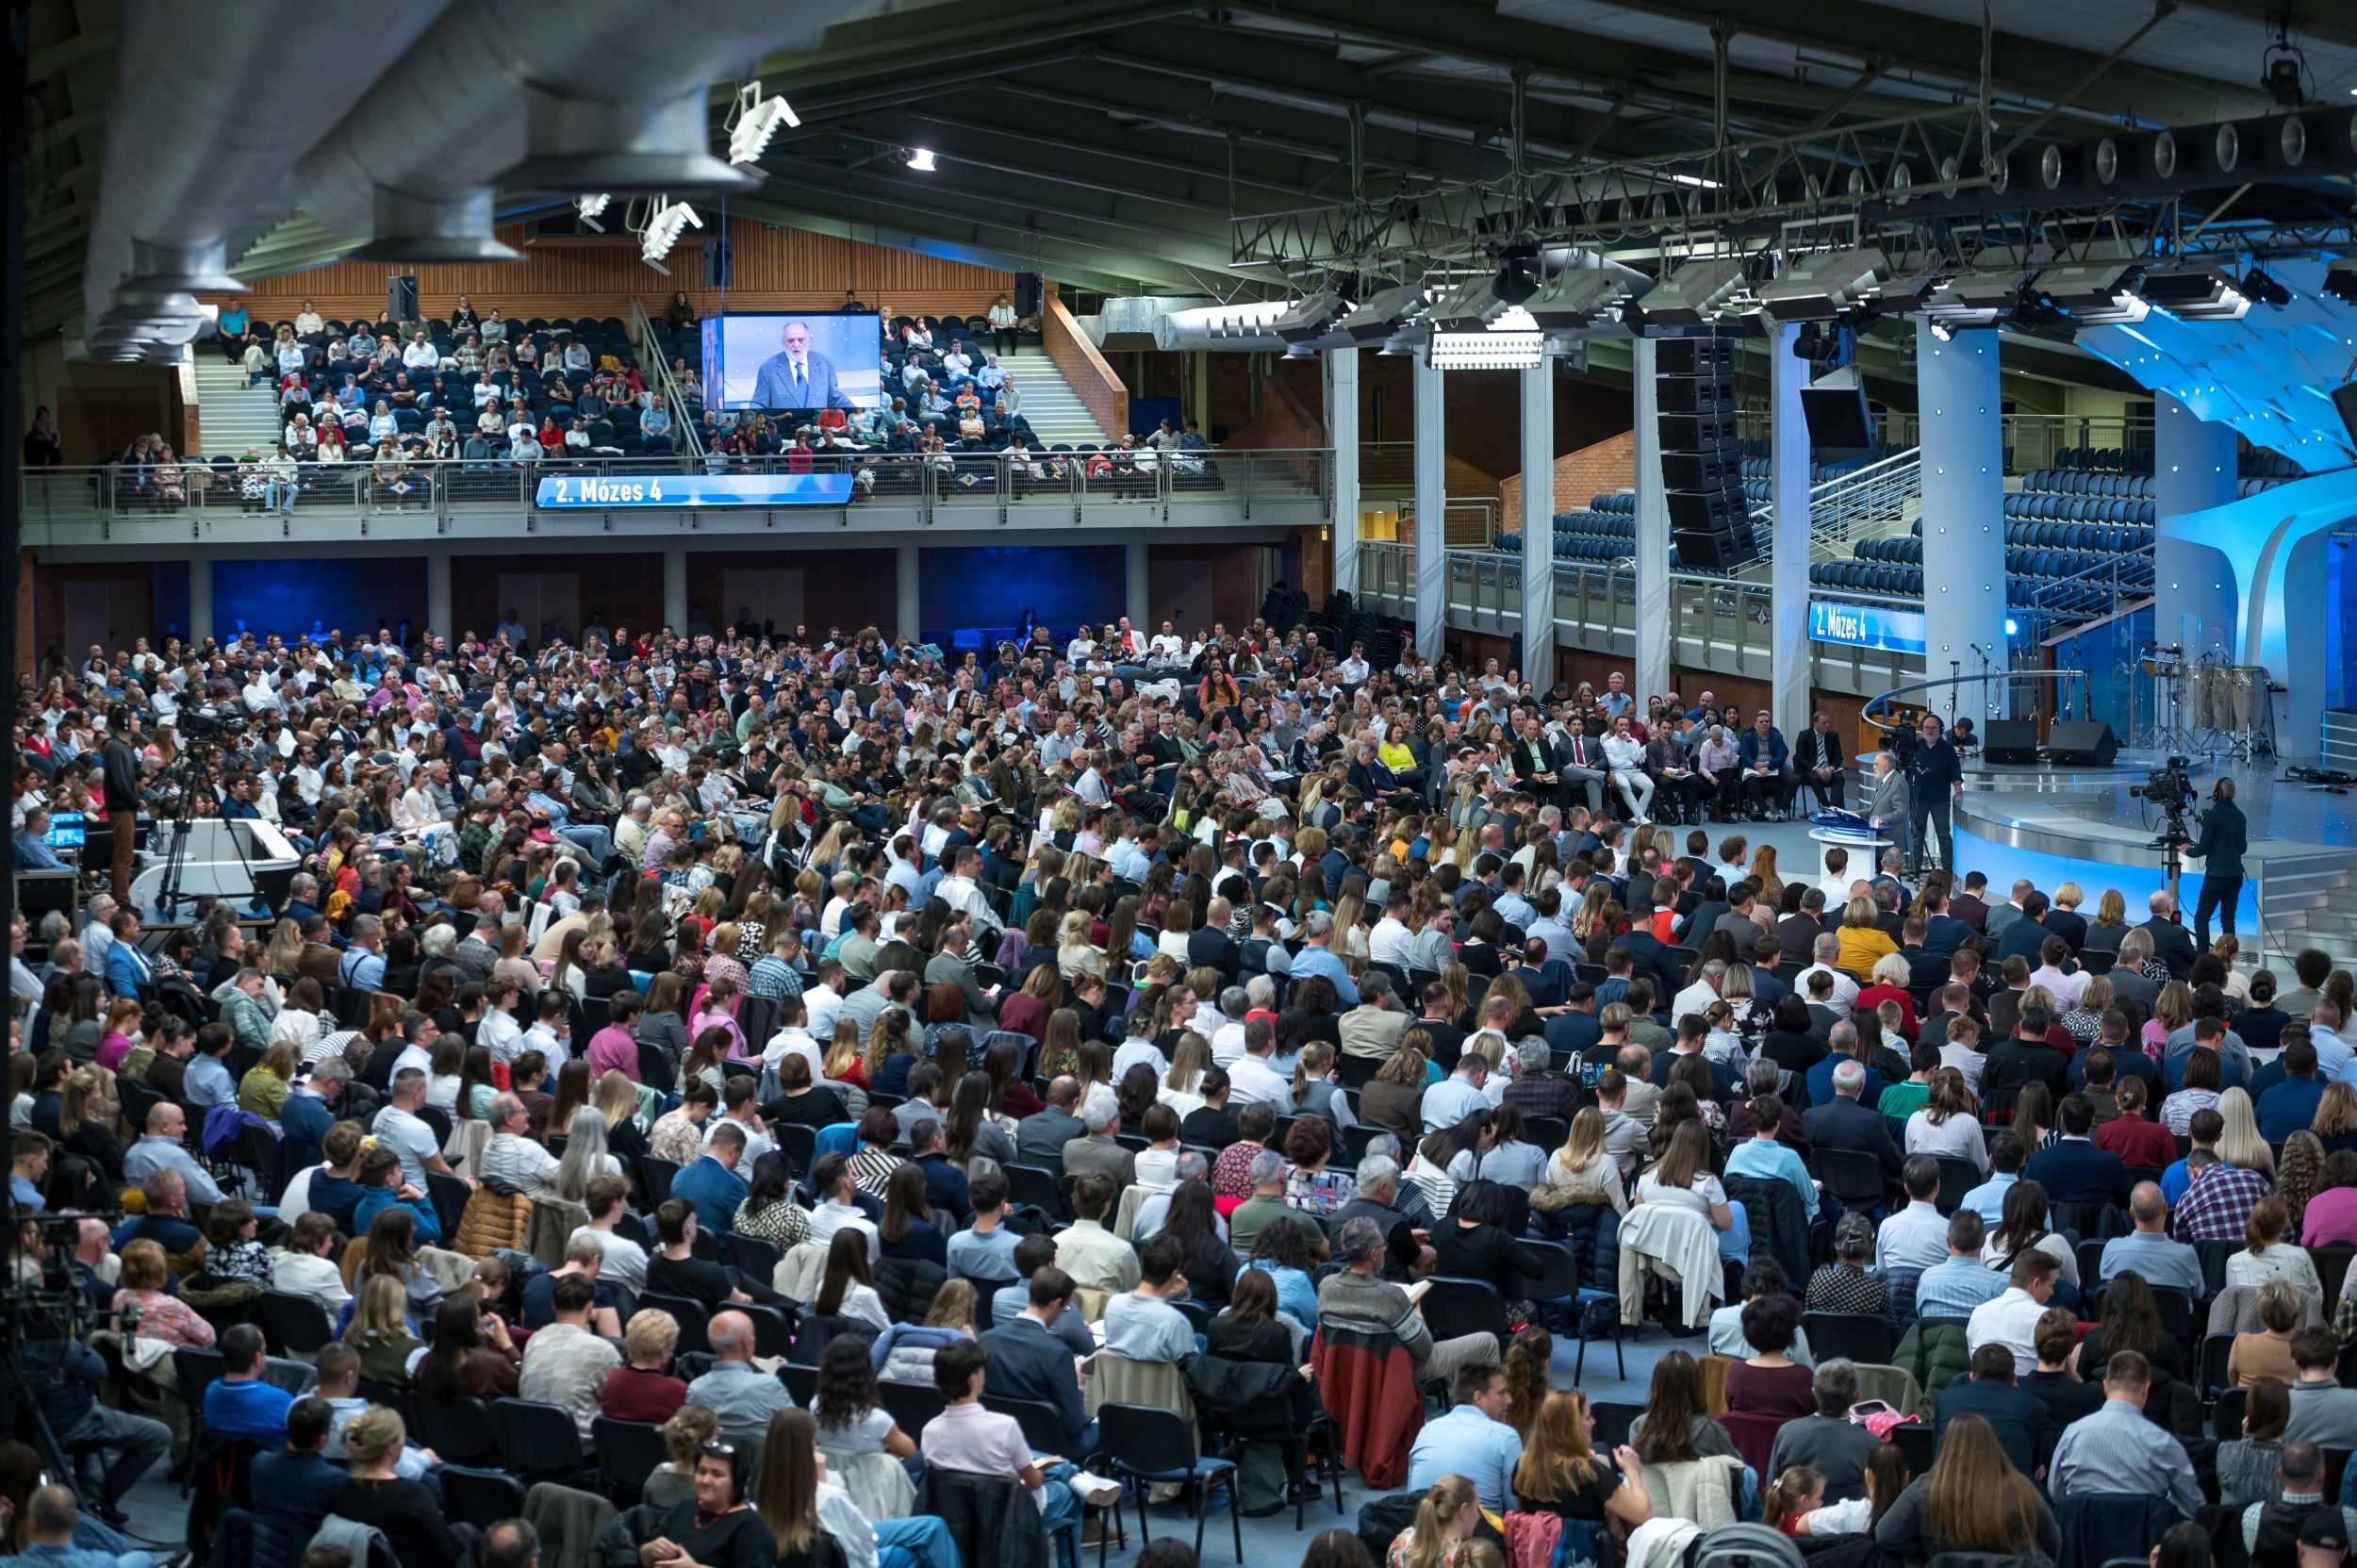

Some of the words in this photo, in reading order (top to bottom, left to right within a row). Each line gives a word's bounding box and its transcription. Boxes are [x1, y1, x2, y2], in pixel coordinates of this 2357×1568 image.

[556, 479, 574, 503] 2.
[581, 478, 643, 502] Mózes
[650, 478, 662, 501] 4
[1817, 605, 1825, 635] 2.
[1828, 606, 1857, 640] Mózes
[1859, 610, 1866, 641] 4
